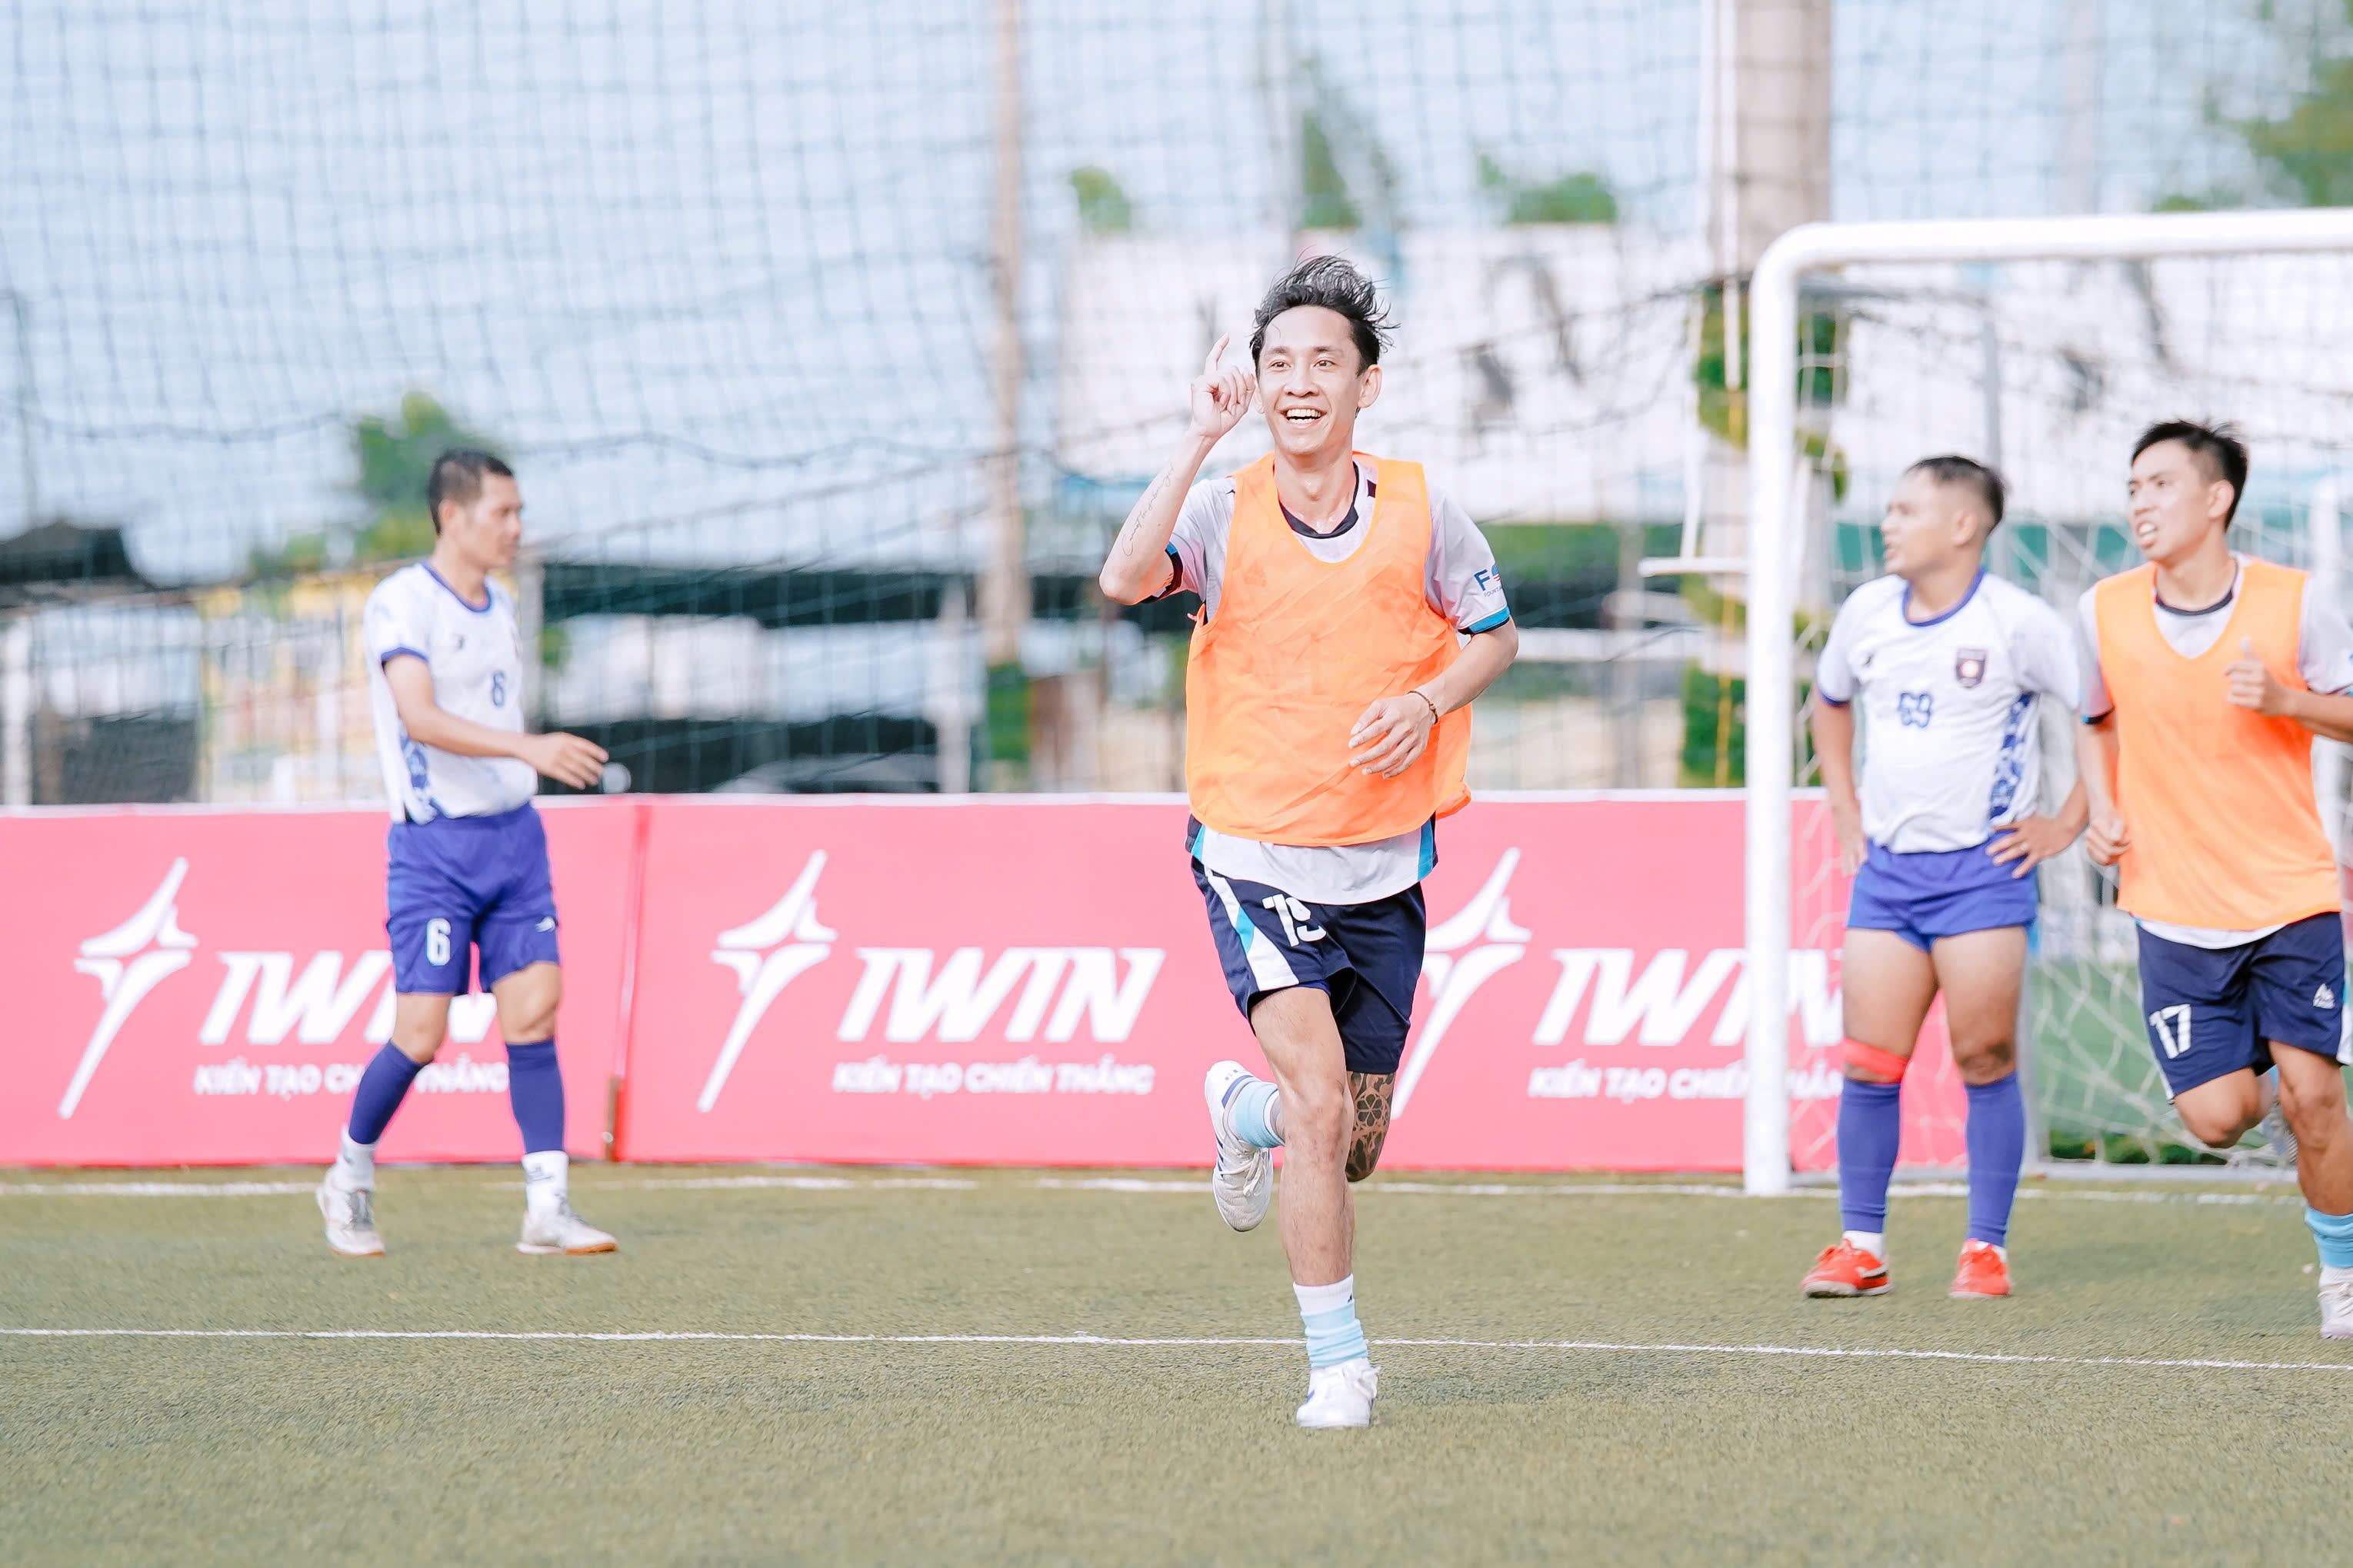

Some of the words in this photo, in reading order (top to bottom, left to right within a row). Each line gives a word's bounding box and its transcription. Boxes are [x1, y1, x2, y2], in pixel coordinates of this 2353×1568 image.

[492, 671, 505, 707] 6
[426, 918, 451, 966] 6
[2149, 1004, 2192, 1059] 17
[832, 1054, 902, 1093] KIẾN
[904, 1062, 963, 1100] TẠO
[964, 1054, 1054, 1094] CHIẾN
[1528, 1058, 1602, 1097] KIẾN
[1605, 1067, 1667, 1104] TẠO
[1668, 1059, 1746, 1099] CHIẾ
